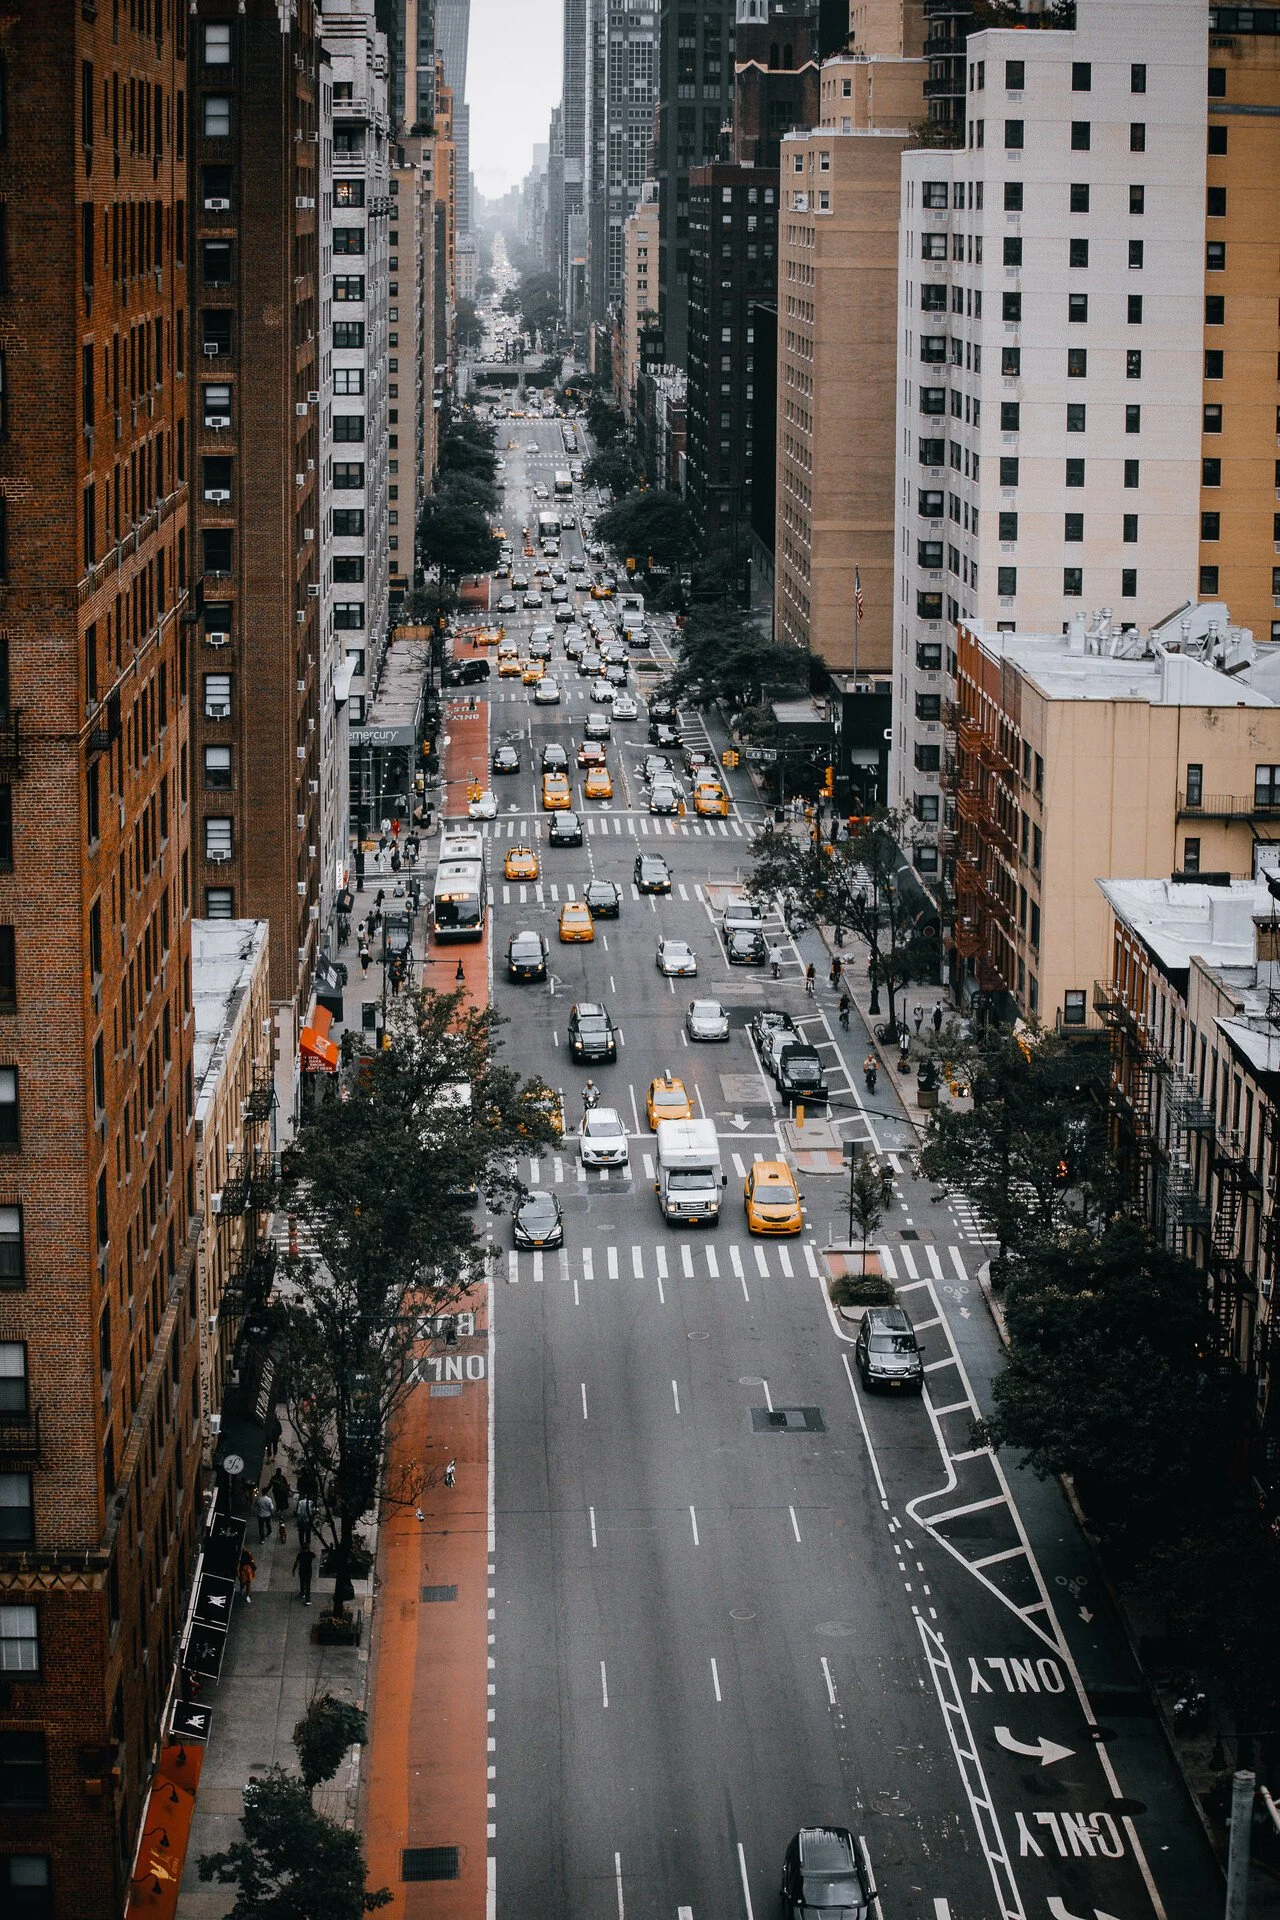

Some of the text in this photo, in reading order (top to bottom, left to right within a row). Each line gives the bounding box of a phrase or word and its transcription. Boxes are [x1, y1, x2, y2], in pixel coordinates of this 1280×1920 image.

[451, 713, 480, 721] ONLY
[405, 1354, 485, 1383] ONLY
[968, 1656, 1065, 1694] ONLY
[1015, 1811, 1125, 1858] ONLY
